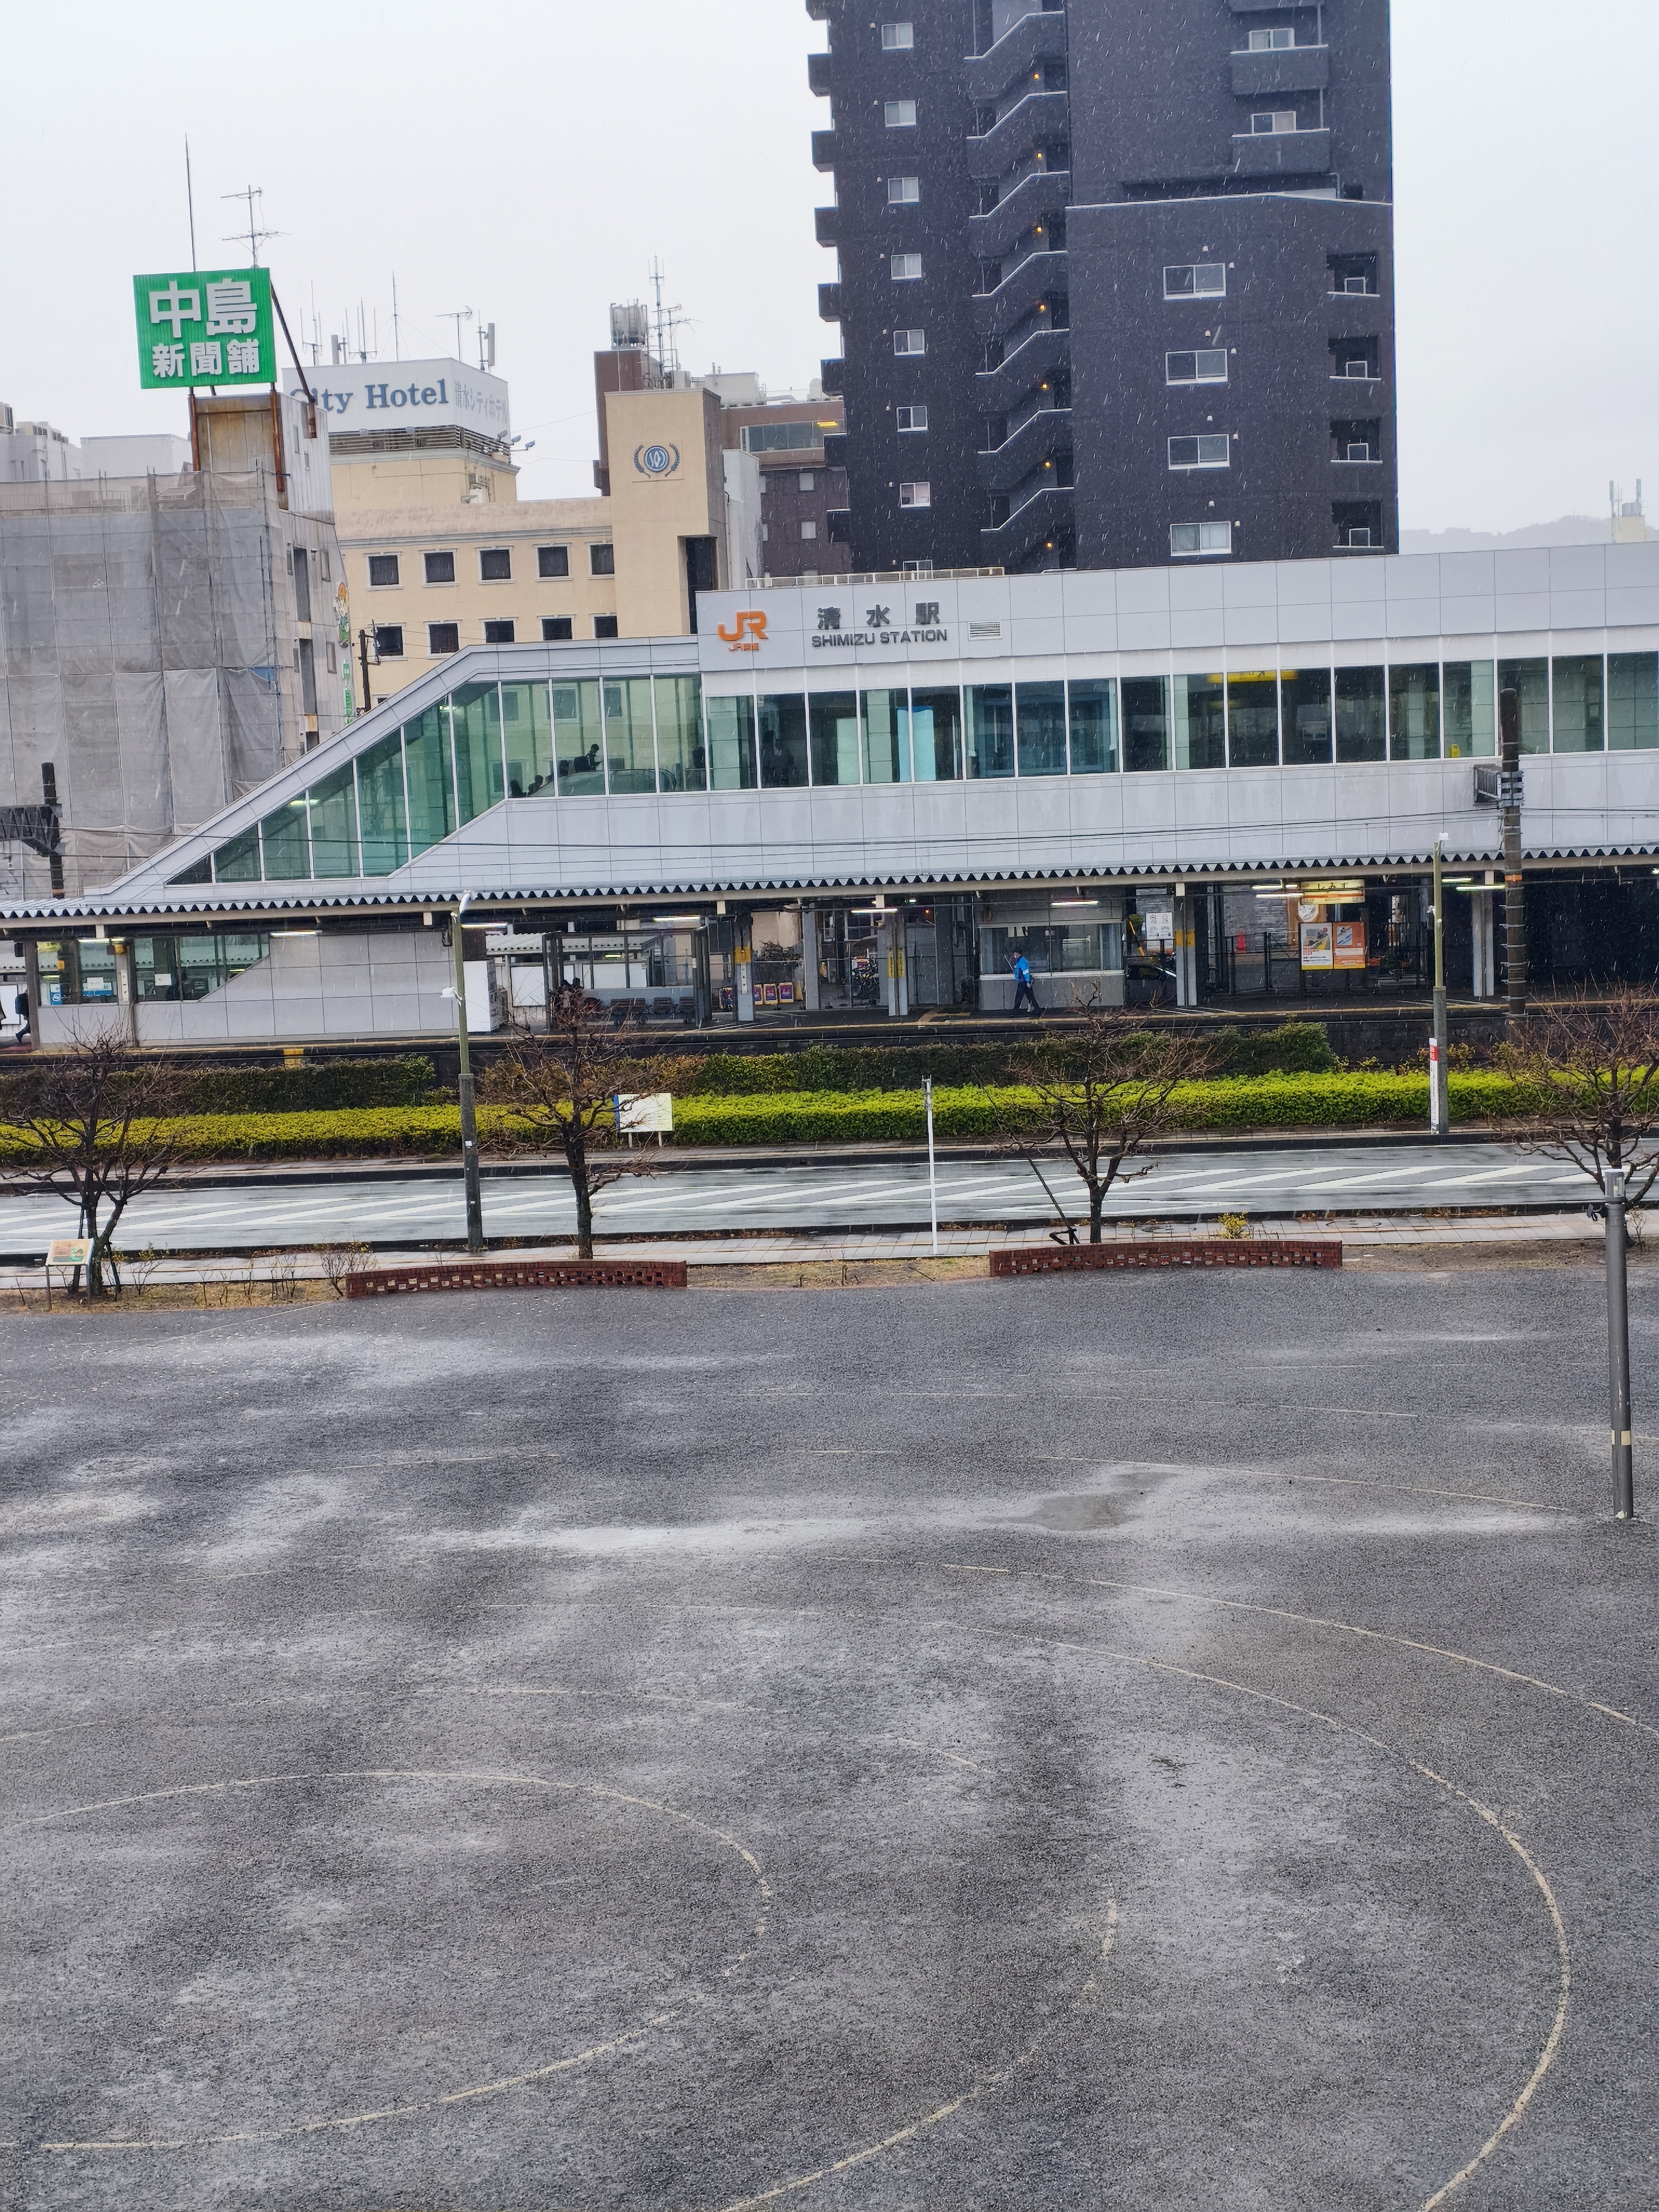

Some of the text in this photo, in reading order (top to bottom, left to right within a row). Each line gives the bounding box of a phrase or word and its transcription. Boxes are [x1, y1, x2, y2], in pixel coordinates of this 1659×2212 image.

[149, 278, 258, 339] 中島
[365, 378, 449, 409] Hotel
[718, 611, 768, 642] JR
[817, 602, 940, 630] 清水駅
[812, 629, 947, 648] SHIMIZU STATION
